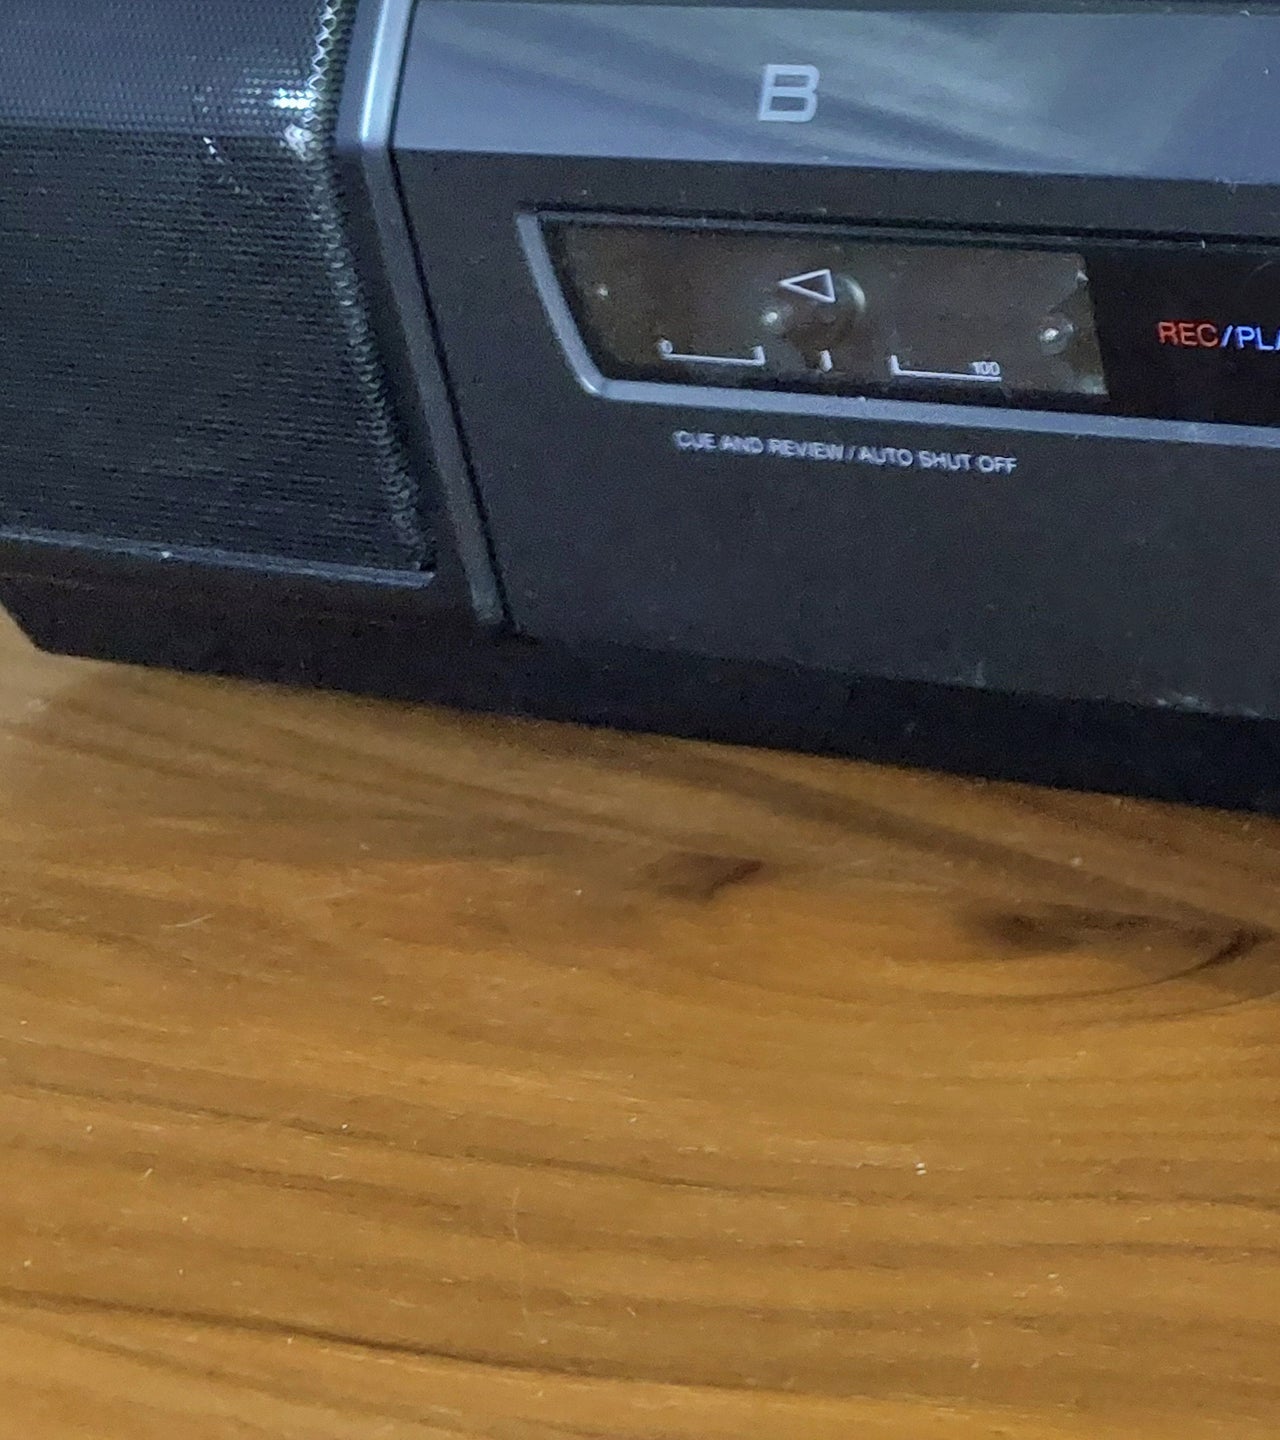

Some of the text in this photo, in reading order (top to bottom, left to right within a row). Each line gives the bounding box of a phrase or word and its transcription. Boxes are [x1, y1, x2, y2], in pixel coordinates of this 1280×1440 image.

[757, 63, 819, 123] B
[674, 430, 717, 451] CUE
[720, 435, 765, 455] AND
[918, 450, 972, 471] SHUT
[977, 454, 1018, 474] OFF
